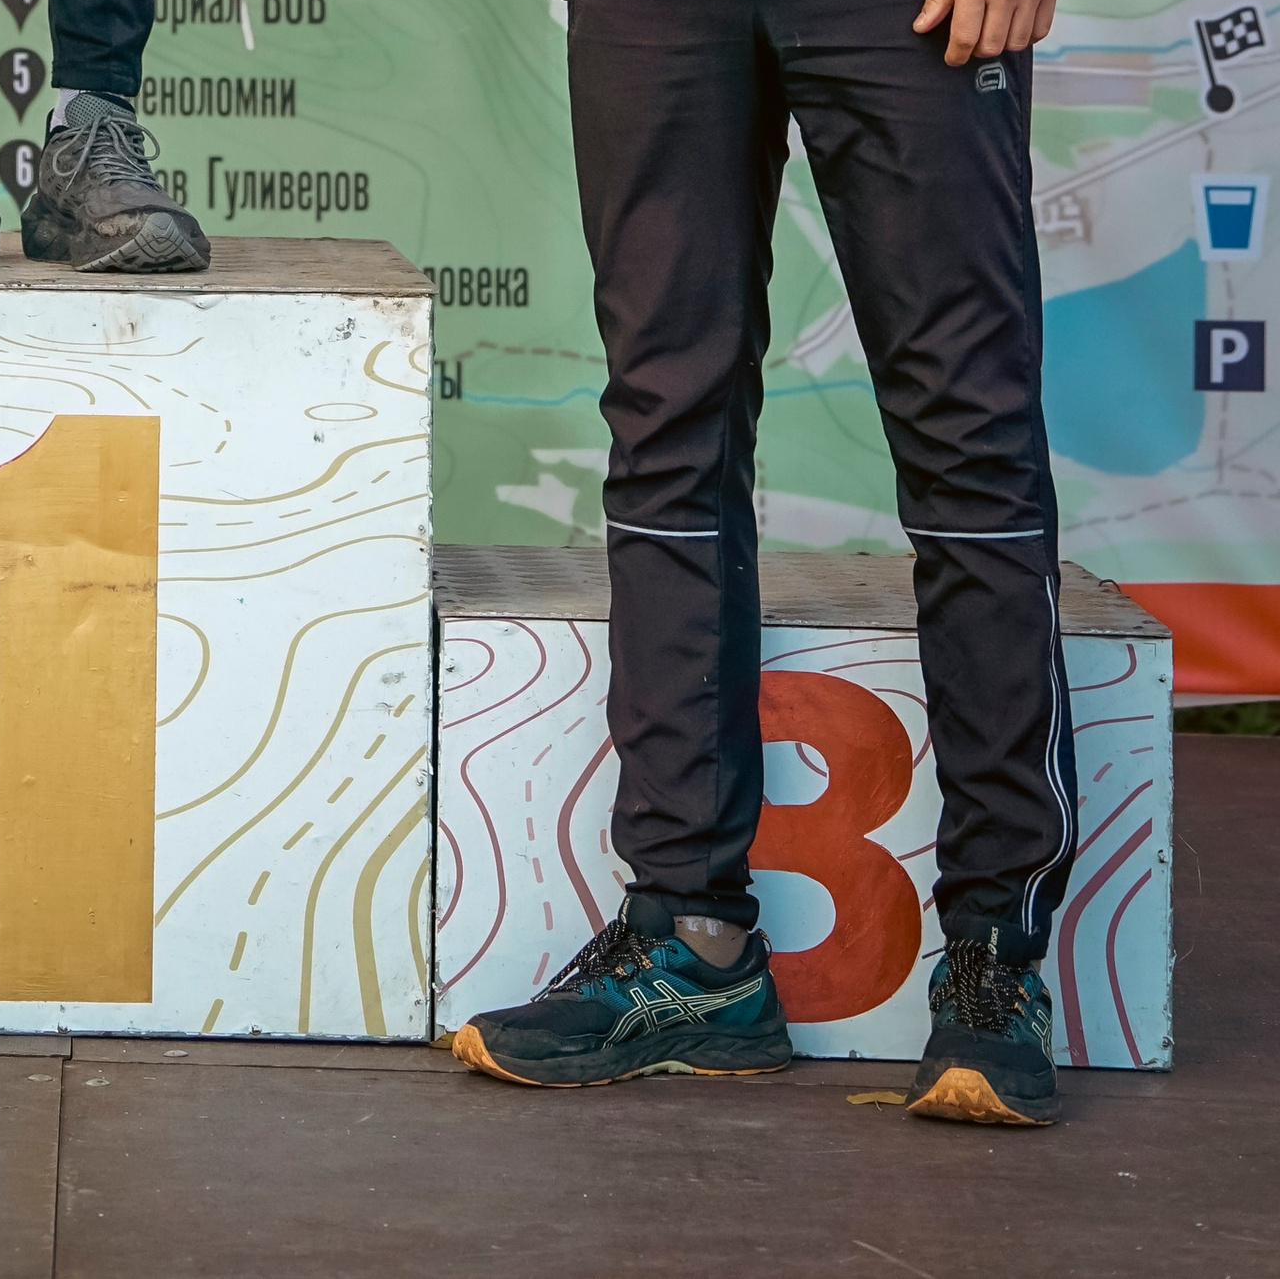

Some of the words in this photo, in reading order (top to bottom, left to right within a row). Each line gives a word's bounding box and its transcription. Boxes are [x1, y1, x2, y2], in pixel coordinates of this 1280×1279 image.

[13, 52, 31, 96] 5
[136, 76, 296, 118] еноломни
[14, 146, 34, 189] 6
[208, 156, 370, 222] Гуливеров
